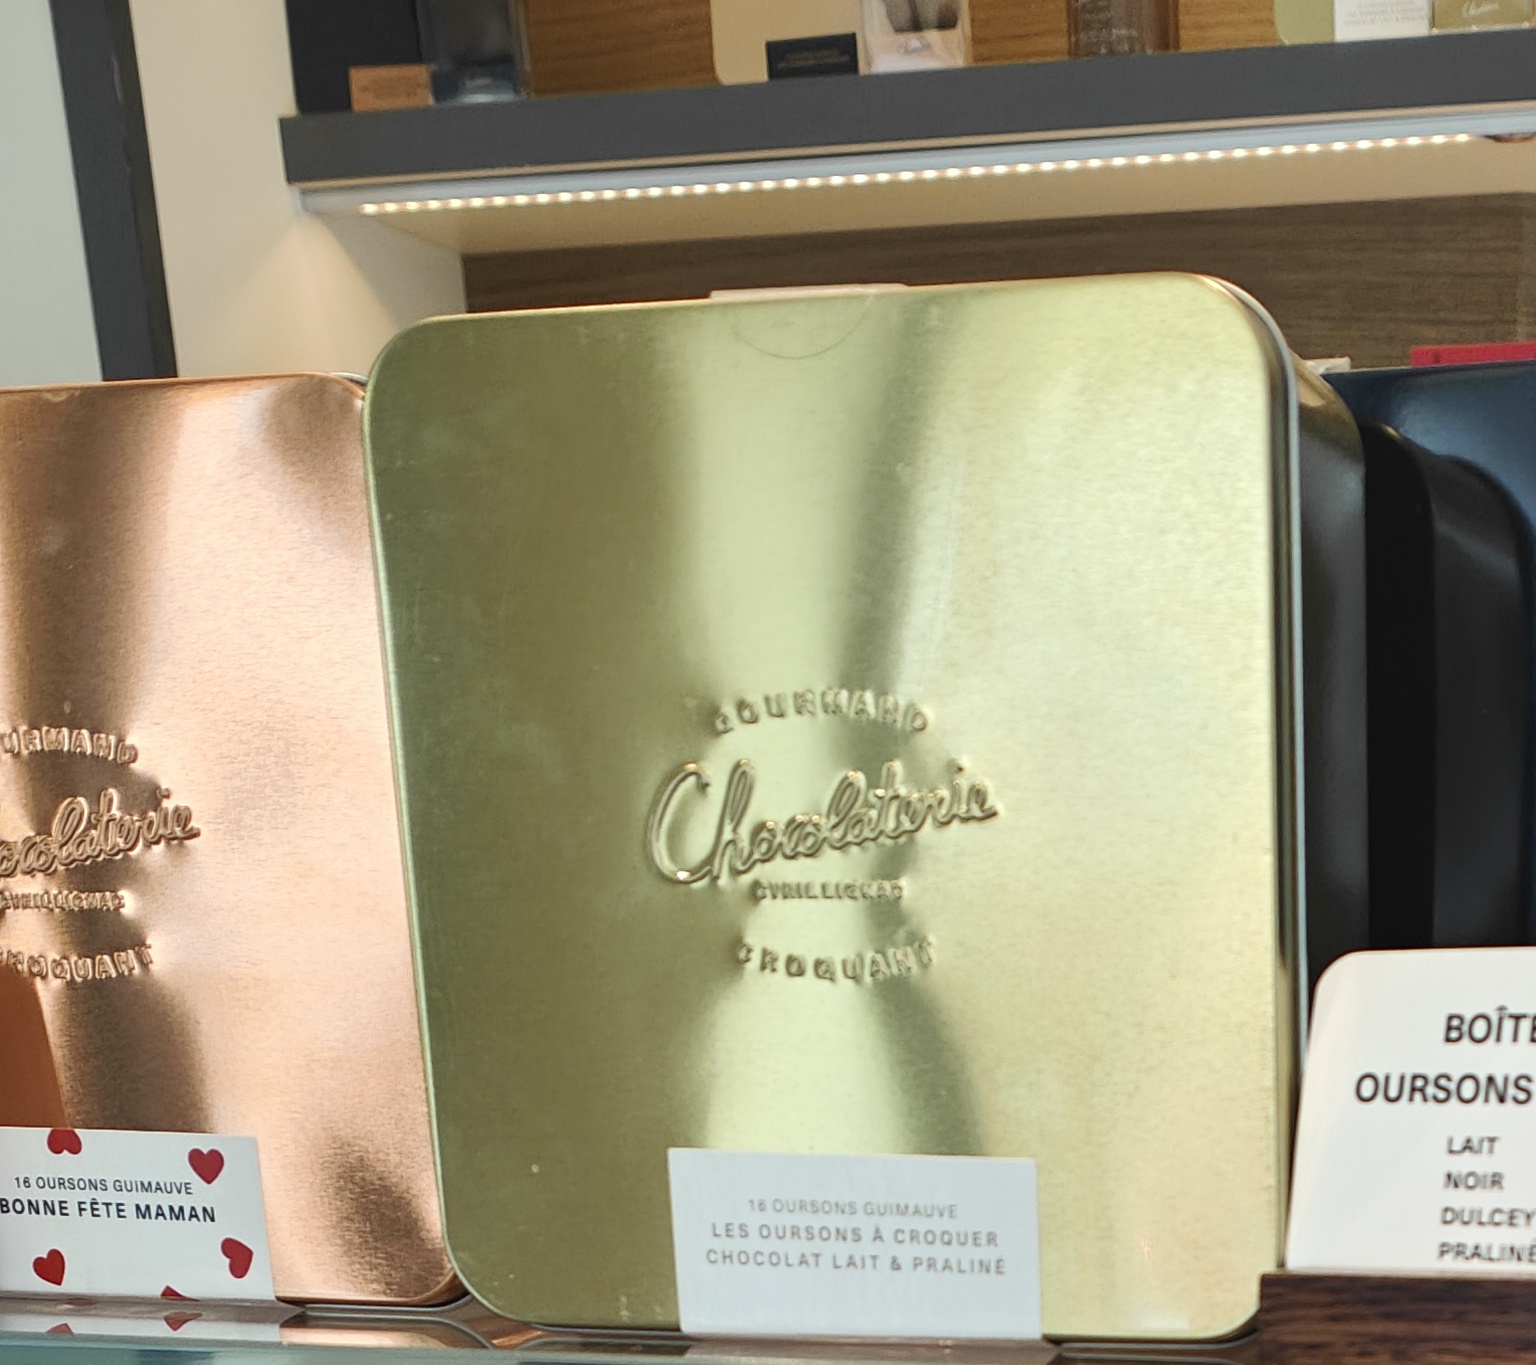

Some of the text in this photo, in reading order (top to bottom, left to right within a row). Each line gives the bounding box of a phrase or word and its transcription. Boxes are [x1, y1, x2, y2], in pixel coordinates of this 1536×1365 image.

[713, 688, 933, 734] GOURMAND
[648, 758, 1000, 885] Chocolaterie
[737, 937, 936, 983] CROQUANT
[1355, 1072, 1533, 1106] OURSONS
[1447, 1136, 1499, 1156] LAIT
[14, 1176, 193, 1196] 16 OURSONS GUIMAUVE
[1443, 1171, 1505, 1192] NOIR
[0, 1197, 217, 1223] BONNE FÊTE MAMAN
[772, 1199, 858, 1215] OURSONS
[863, 1201, 957, 1219] GUIMAUVE
[1441, 1206, 1536, 1228] DULCEY
[712, 1222, 999, 1247] LES OURSONS À CROQUER
[706, 1249, 1006, 1275] CHOCOLAT LAIT & PRALINÉ
